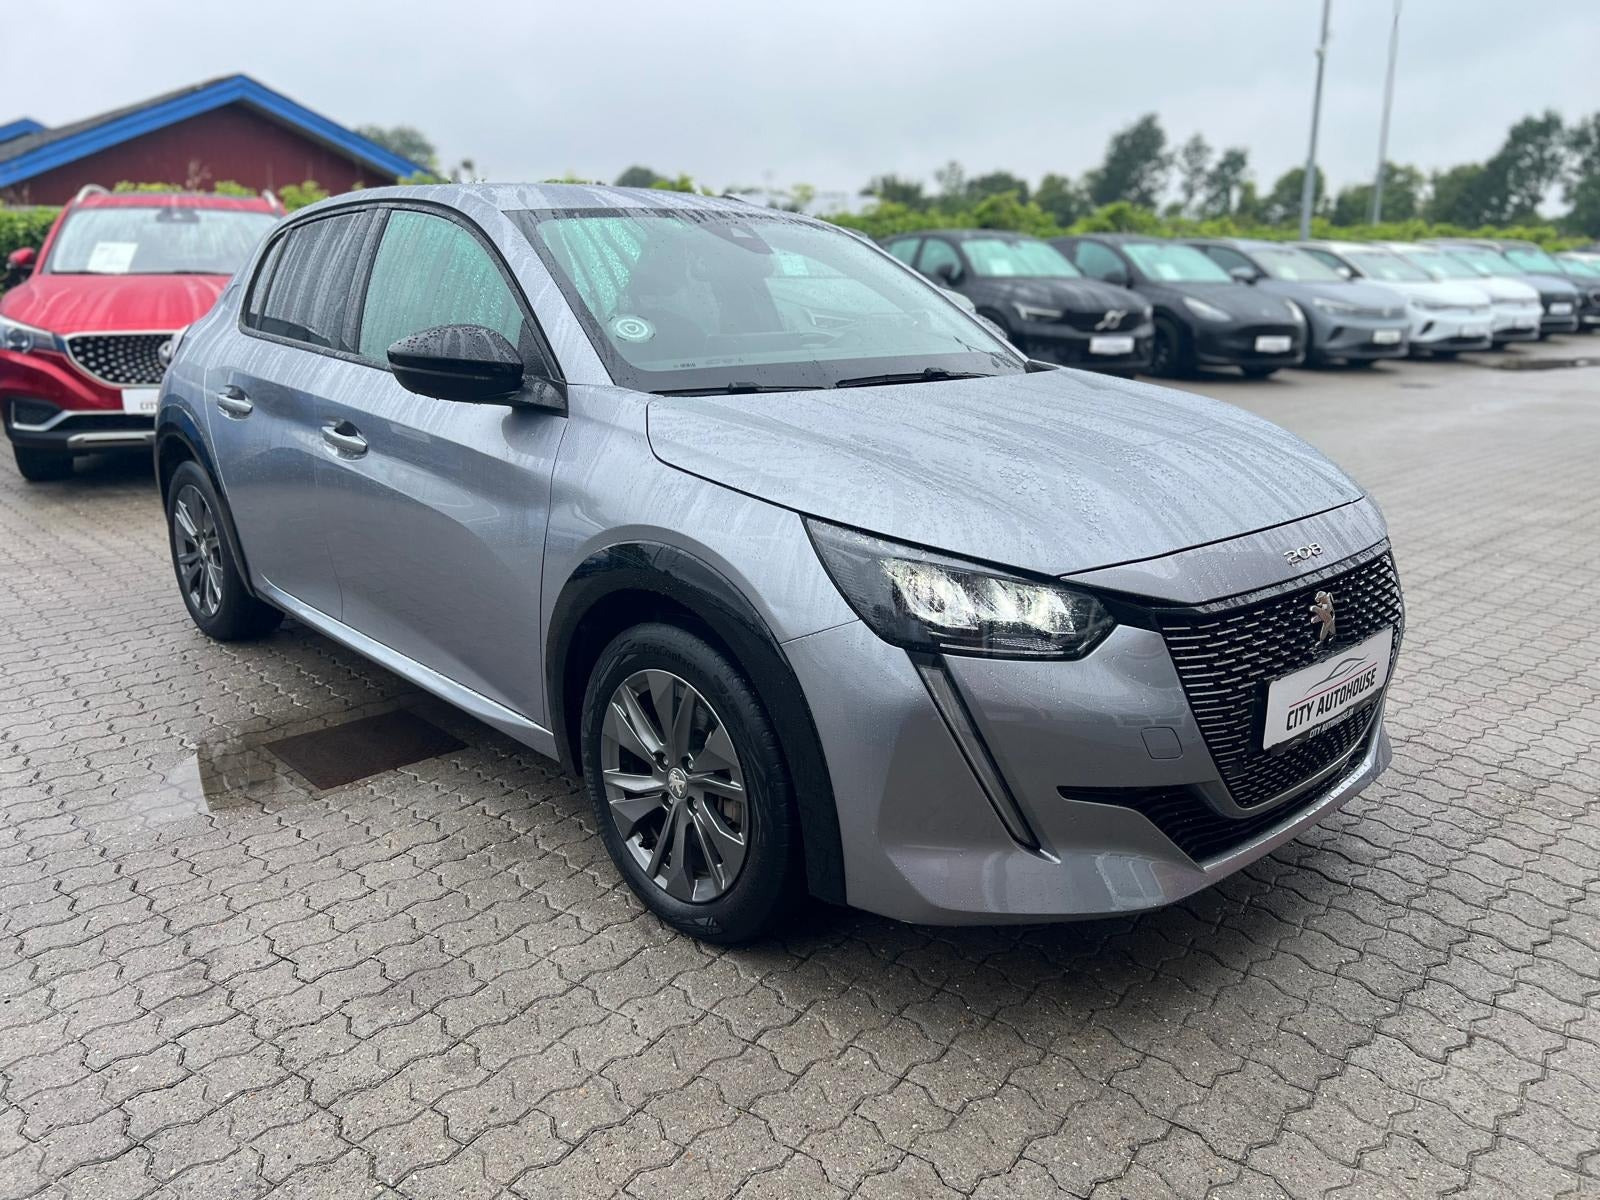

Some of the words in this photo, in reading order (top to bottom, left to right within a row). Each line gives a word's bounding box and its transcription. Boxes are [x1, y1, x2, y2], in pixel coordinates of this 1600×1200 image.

[1283, 542, 1323, 564] 208
[1286, 700, 1315, 731] CITY
[1315, 667, 1377, 717] AUTOHOUSE
